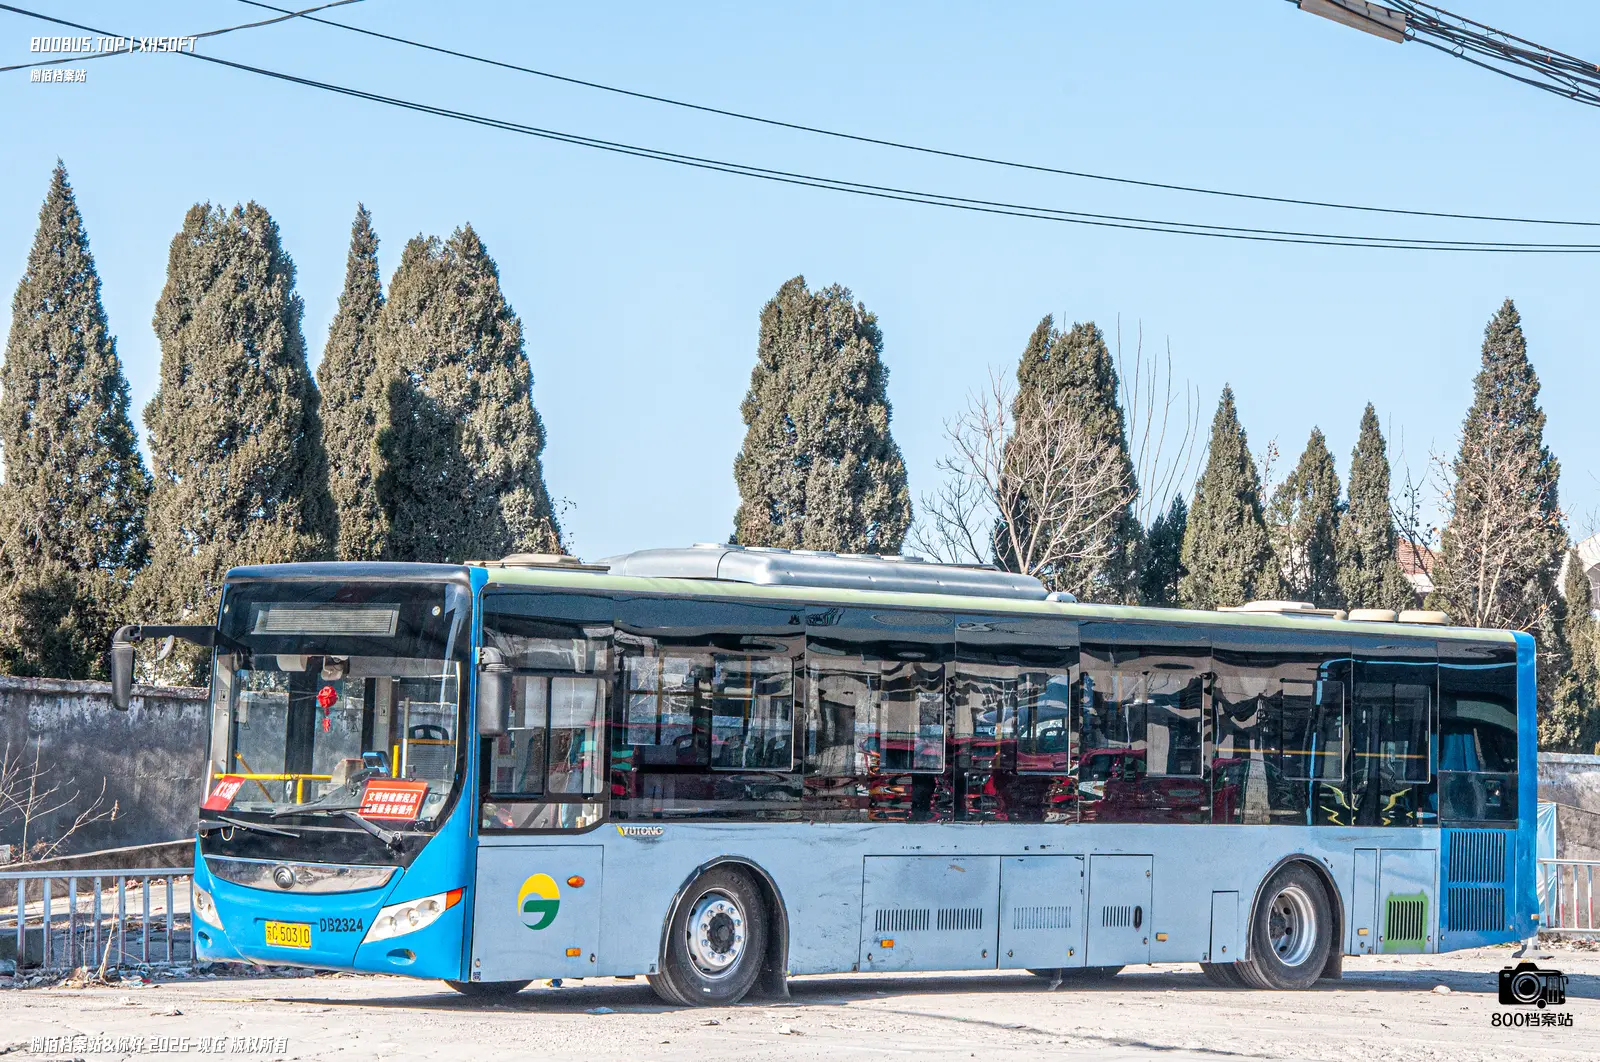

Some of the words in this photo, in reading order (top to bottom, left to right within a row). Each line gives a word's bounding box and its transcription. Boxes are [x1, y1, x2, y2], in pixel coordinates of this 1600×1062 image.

[366, 791, 418, 804] 文明创建新起点
[363, 803, 413, 816] 优质服务新提升
[622, 826, 664, 836] YUTONG
[319, 918, 364, 932] DB2324
